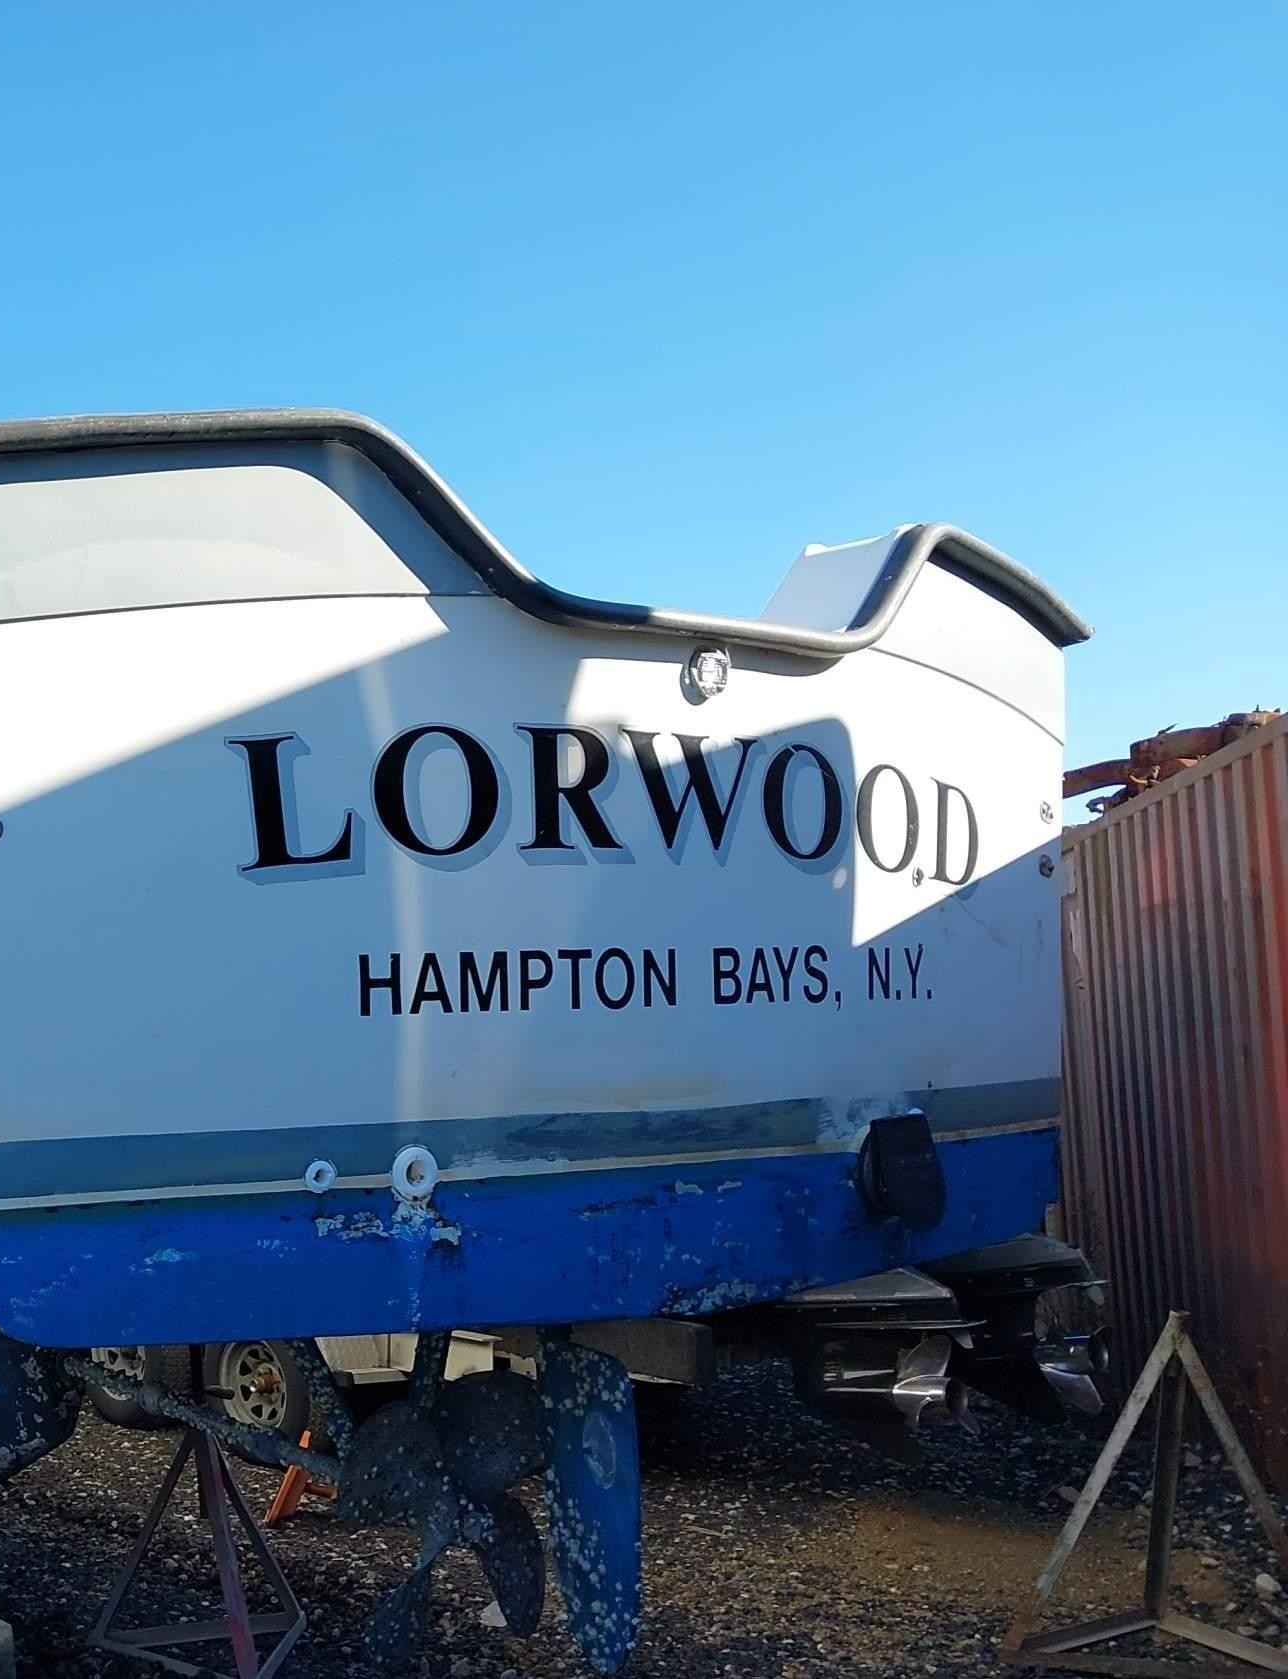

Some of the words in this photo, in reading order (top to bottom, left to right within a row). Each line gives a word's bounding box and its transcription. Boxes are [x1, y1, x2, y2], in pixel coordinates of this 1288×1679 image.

[225, 722, 979, 886] LORWOOD
[357, 947, 678, 1017] HAMPTON
[712, 944, 843, 1011] BAYS,
[867, 946, 933, 1001] N.Y.
